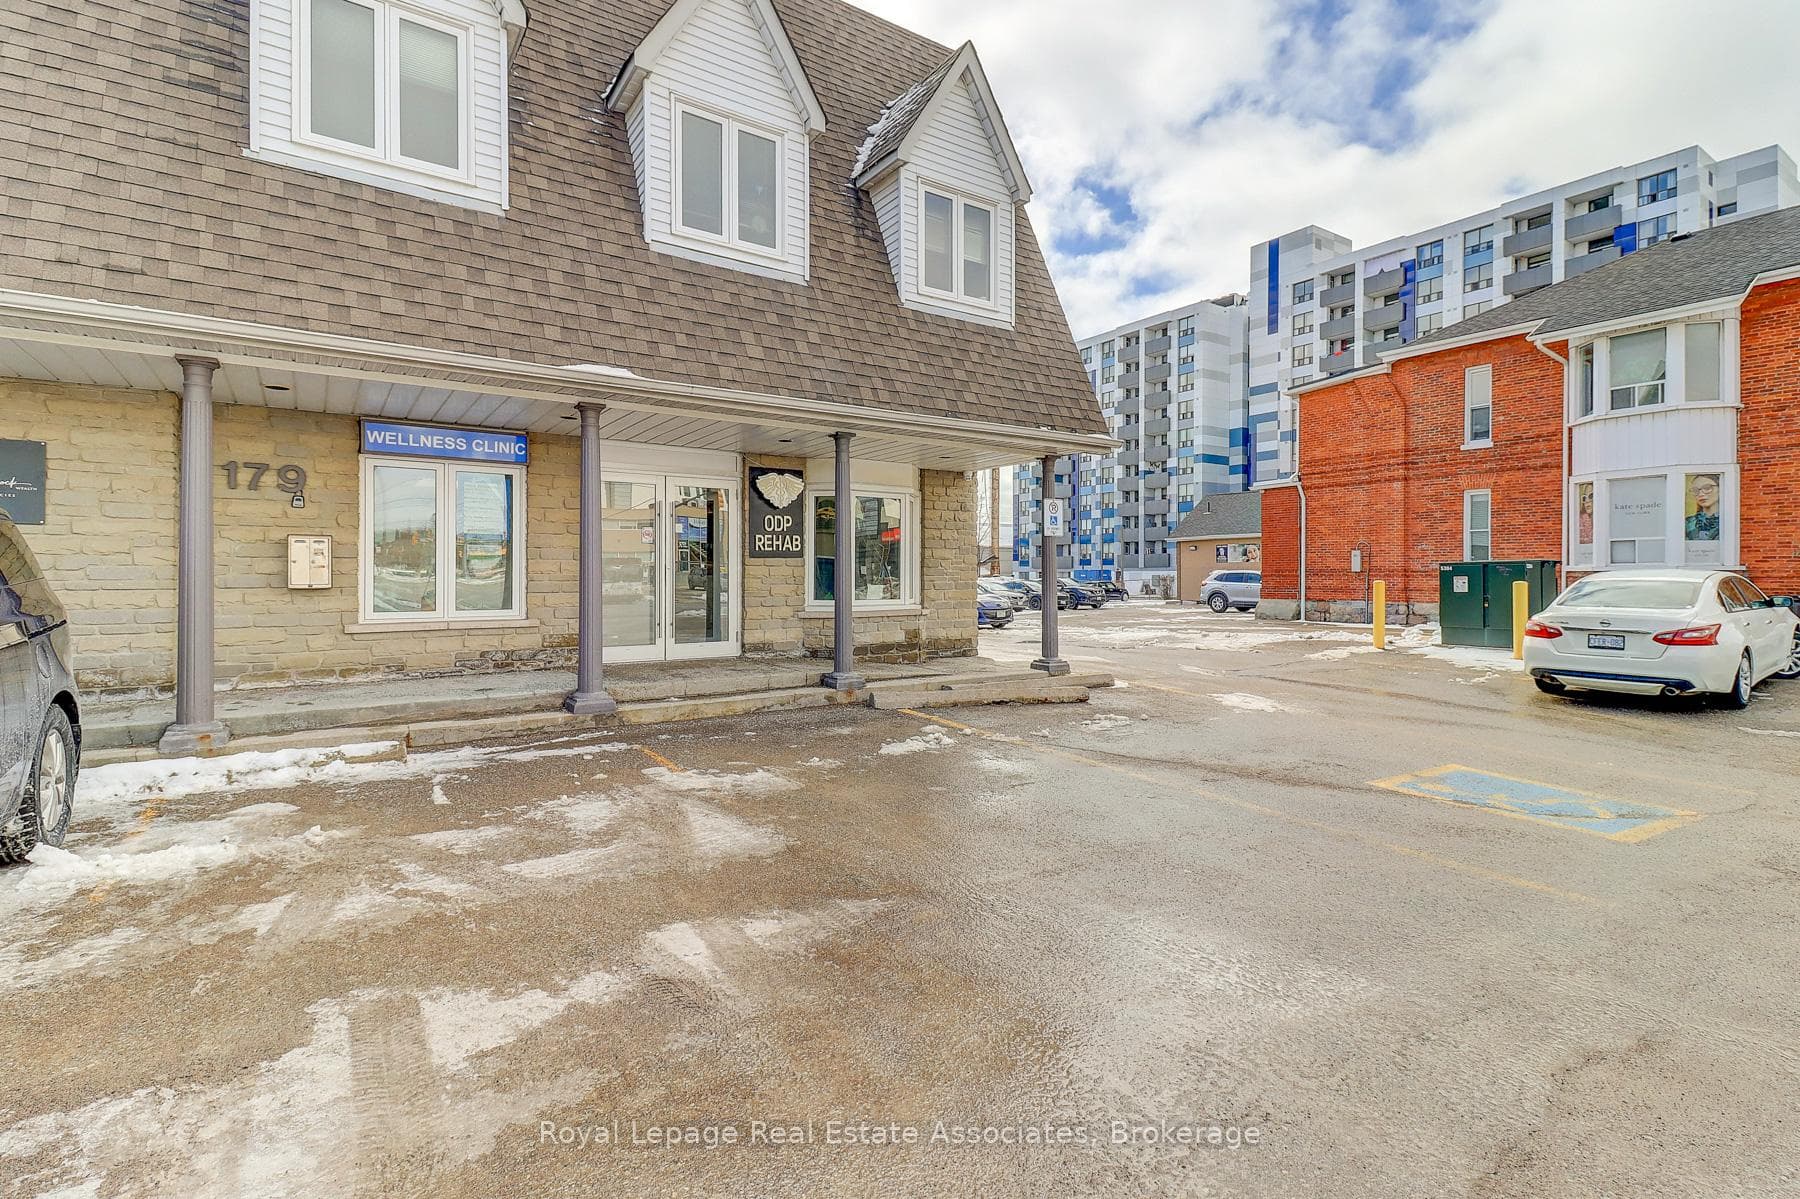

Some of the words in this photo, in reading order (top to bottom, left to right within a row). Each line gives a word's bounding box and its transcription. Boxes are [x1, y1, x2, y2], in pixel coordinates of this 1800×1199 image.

[367, 430, 467, 451] WELLNESS
[472, 439, 526, 455] CLINIC
[221, 461, 306, 493] 179
[1635, 502, 1662, 510] spade
[764, 515, 792, 531] ODP
[755, 534, 801, 552] REHAB
